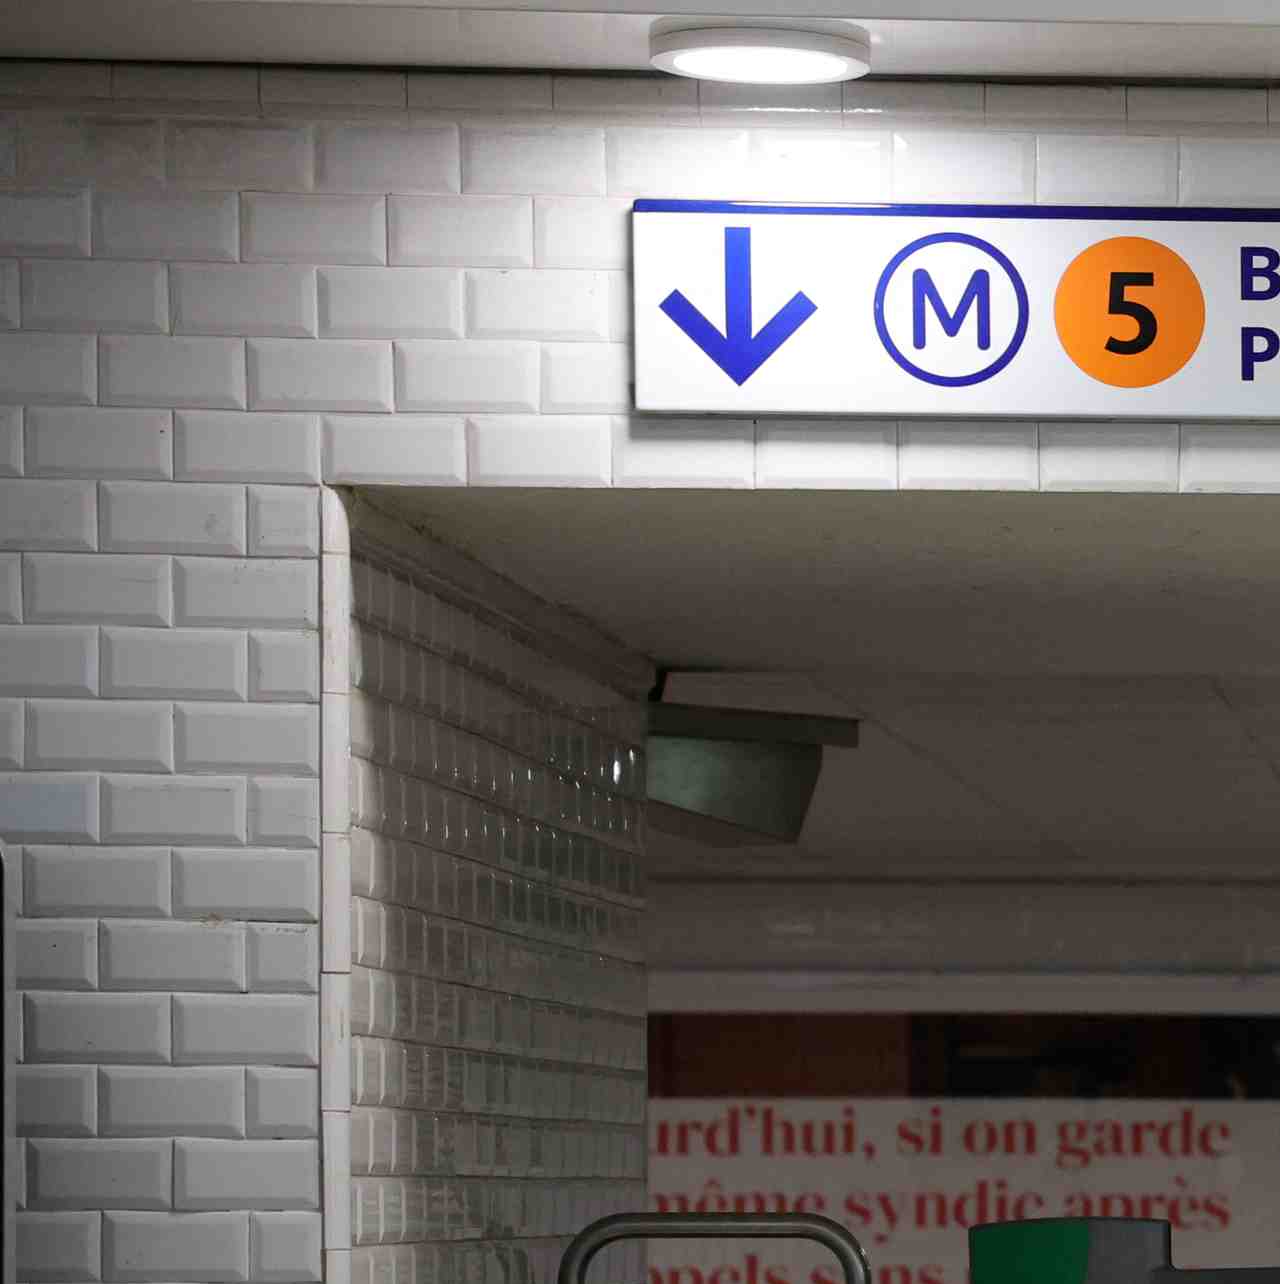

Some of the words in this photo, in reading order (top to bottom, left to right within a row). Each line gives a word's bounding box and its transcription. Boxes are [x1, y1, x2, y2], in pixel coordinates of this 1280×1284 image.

[912, 267, 990, 351] M
[1103, 271, 1159, 355] 5
[896, 1106, 944, 1158] si
[963, 1119, 1038, 1157] on
[1055, 1108, 1231, 1169] garde
[845, 1178, 1045, 1243] syndic
